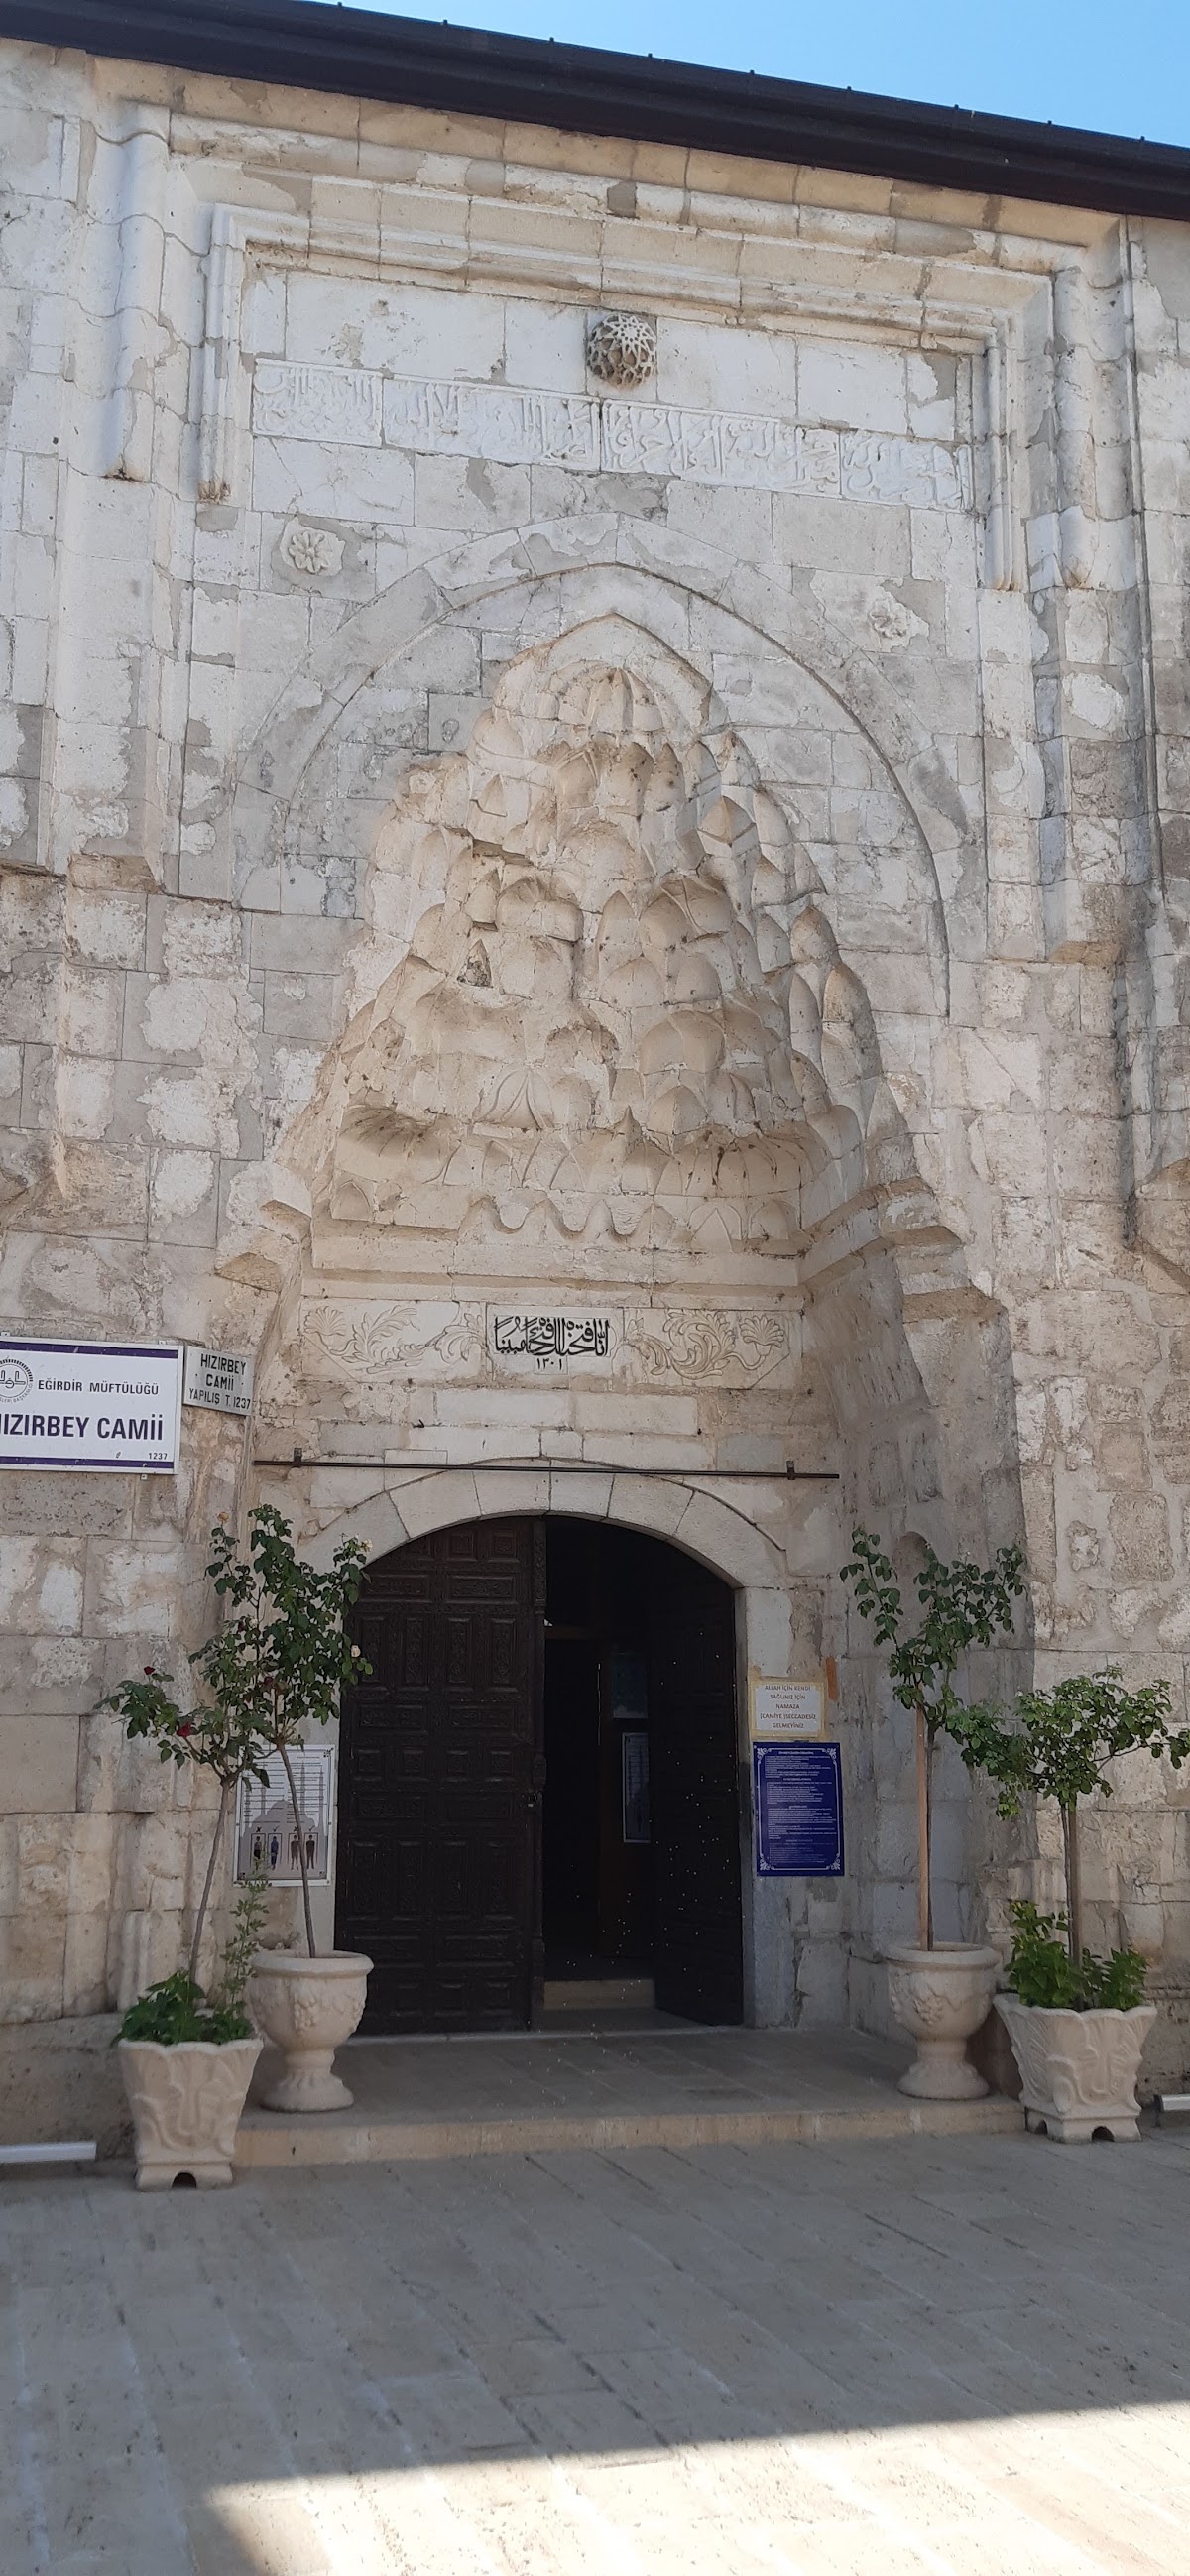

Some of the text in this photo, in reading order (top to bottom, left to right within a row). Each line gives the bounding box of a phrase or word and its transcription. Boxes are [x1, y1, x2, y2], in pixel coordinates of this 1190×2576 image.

[200, 1353, 247, 1376] HIZIRBEY
[38, 1377, 160, 1396] EĞİRDİR MÜFTÜLÜĞÜ
[205, 1373, 234, 1391] CAMİİ
[188, 1388, 220, 1405] YAPILIŞ
[0, 1413, 163, 1441] IZIRBEY CAMİİ
[148, 1452, 169, 1461] 1237
